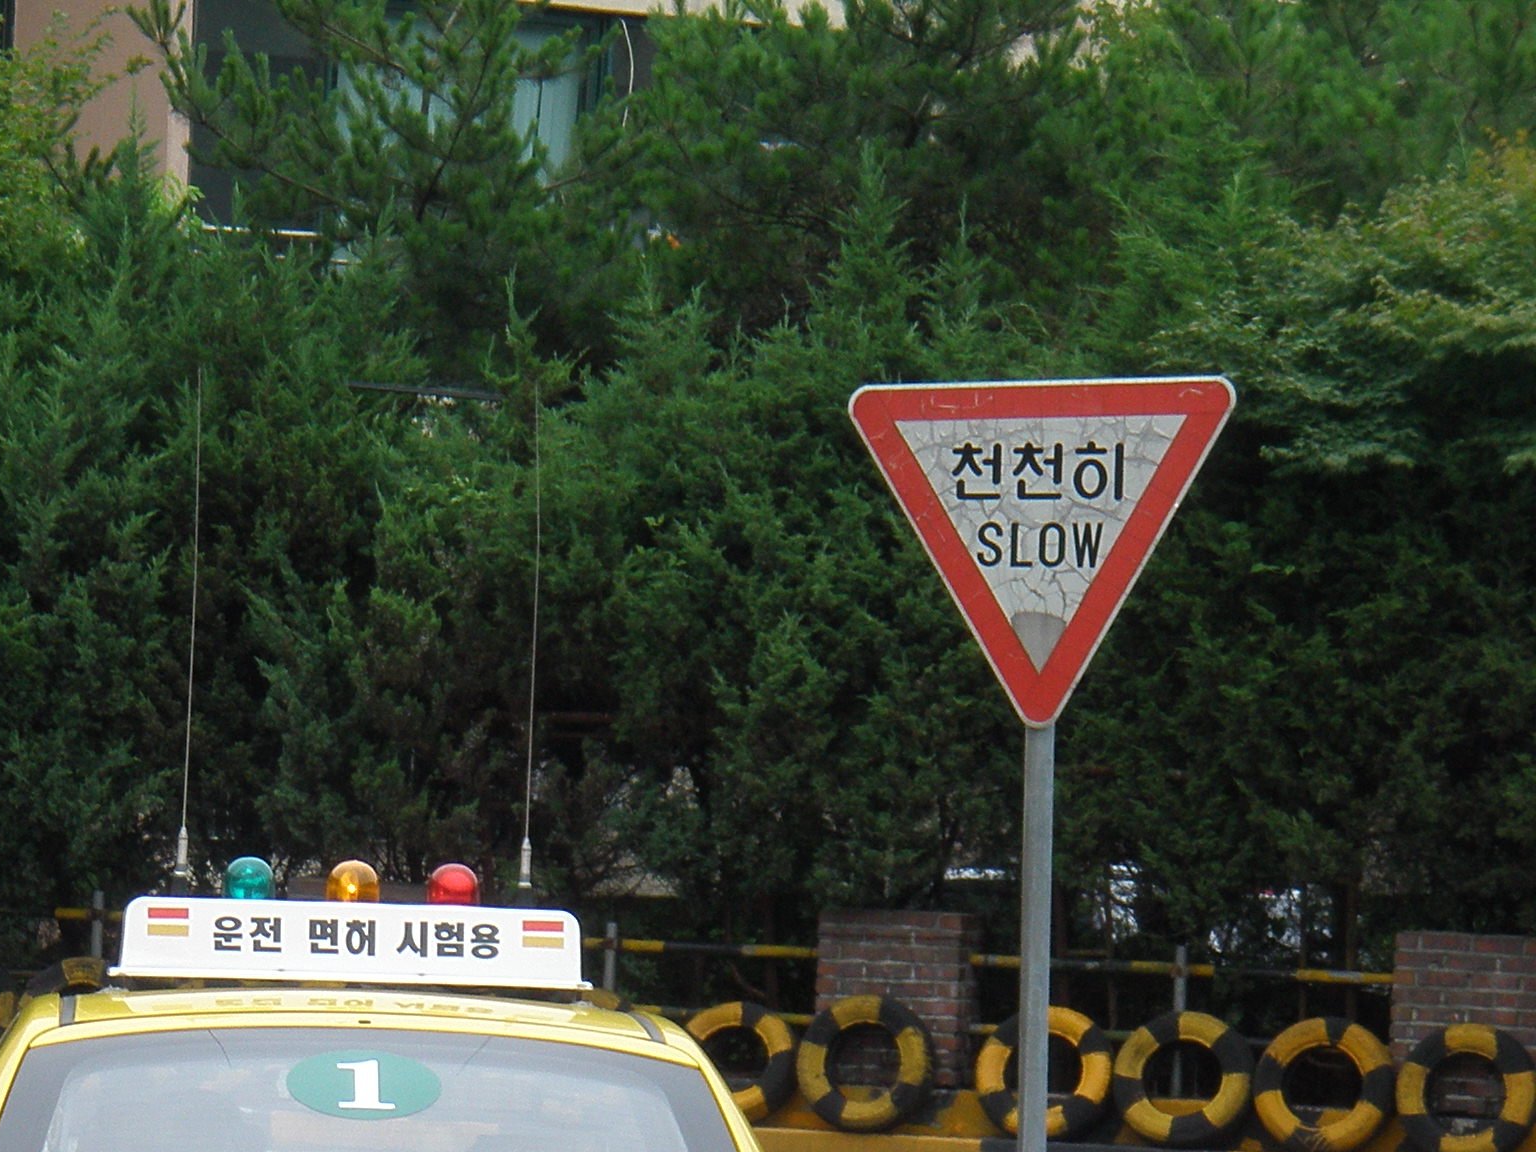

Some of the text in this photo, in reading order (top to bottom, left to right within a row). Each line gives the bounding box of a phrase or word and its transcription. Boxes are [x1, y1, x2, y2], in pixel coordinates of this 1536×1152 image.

[951, 441, 1126, 502] 천천히
[977, 521, 1103, 569] SLOW
[212, 916, 501, 960] 운전 면허 시험용
[336, 1058, 397, 1111] 1
